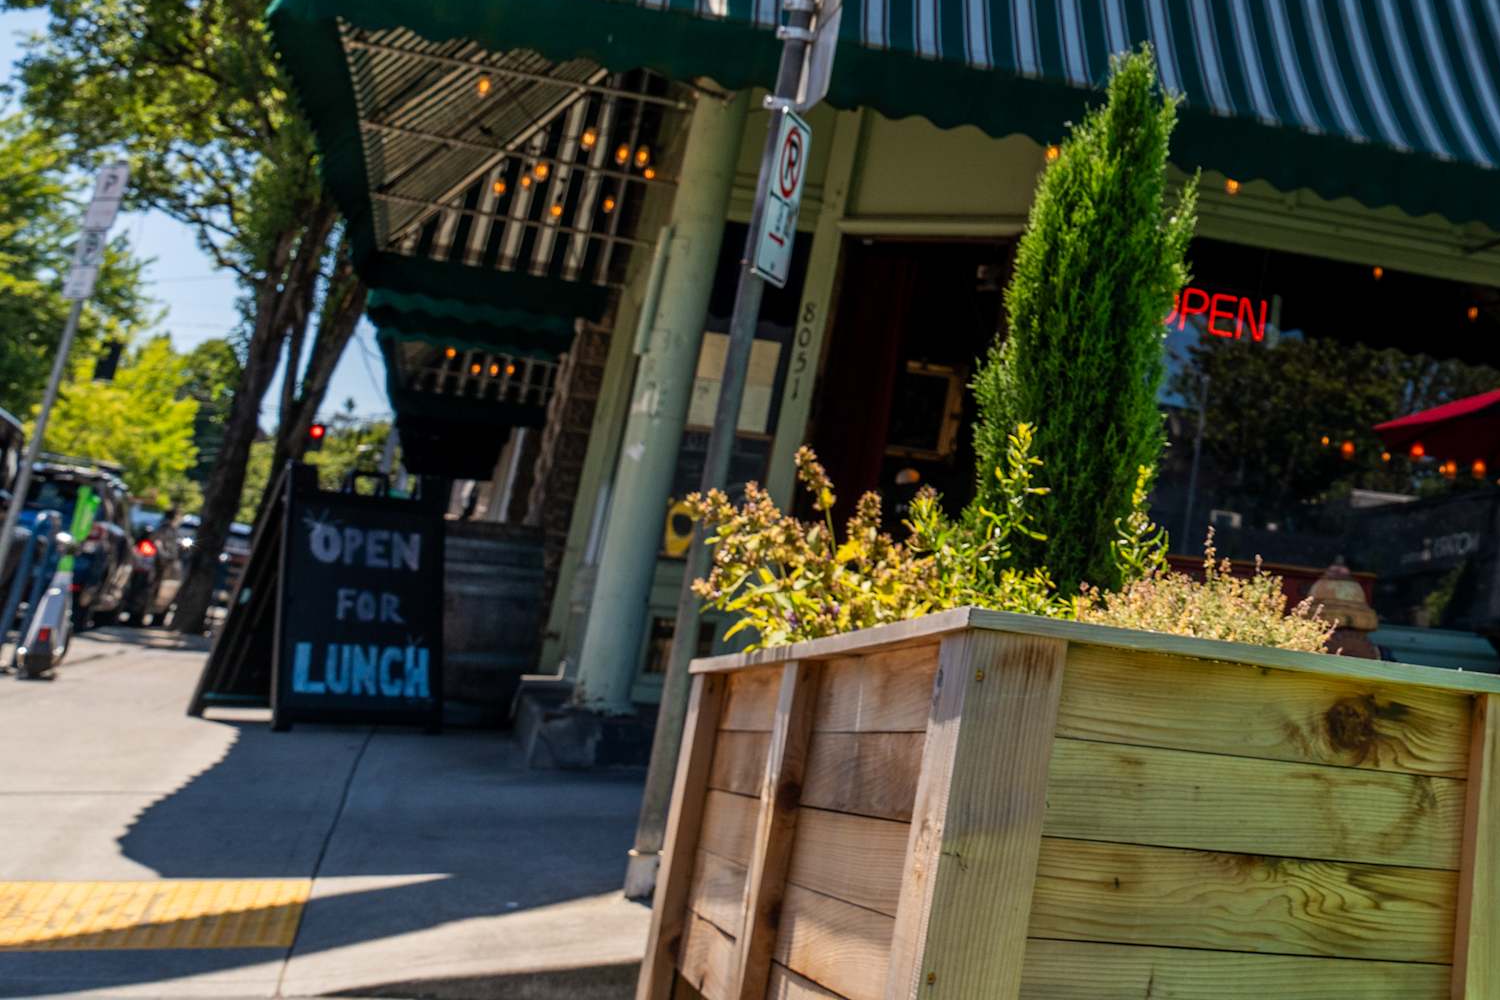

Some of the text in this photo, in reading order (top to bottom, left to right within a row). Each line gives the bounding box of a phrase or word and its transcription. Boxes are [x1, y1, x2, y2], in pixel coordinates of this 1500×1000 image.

[791, 302, 817, 401] 8051
[309, 522, 421, 571] OPEN
[336, 587, 407, 624] FOR
[293, 641, 431, 698] LUNCH
